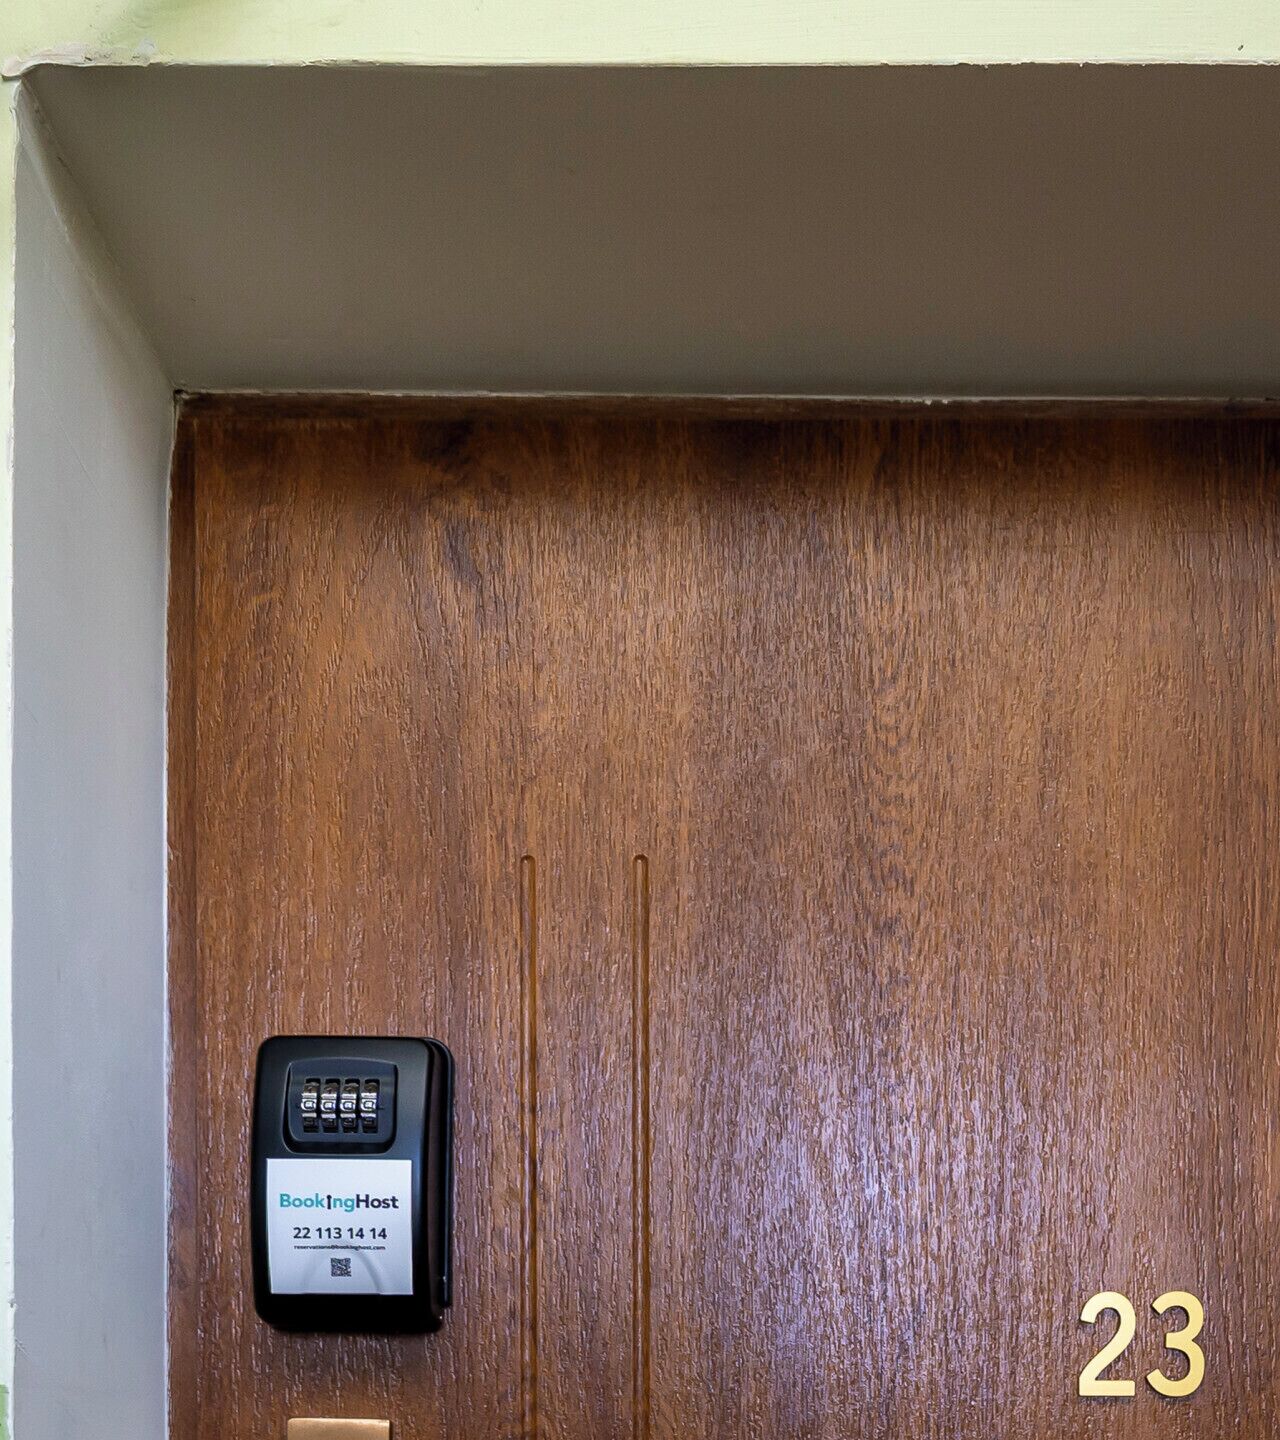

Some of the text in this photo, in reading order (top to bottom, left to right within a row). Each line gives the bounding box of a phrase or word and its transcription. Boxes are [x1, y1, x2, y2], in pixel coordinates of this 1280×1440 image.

[293, 1227, 387, 1240] 22 113 14 14
[1078, 1290, 1206, 1398] 23
